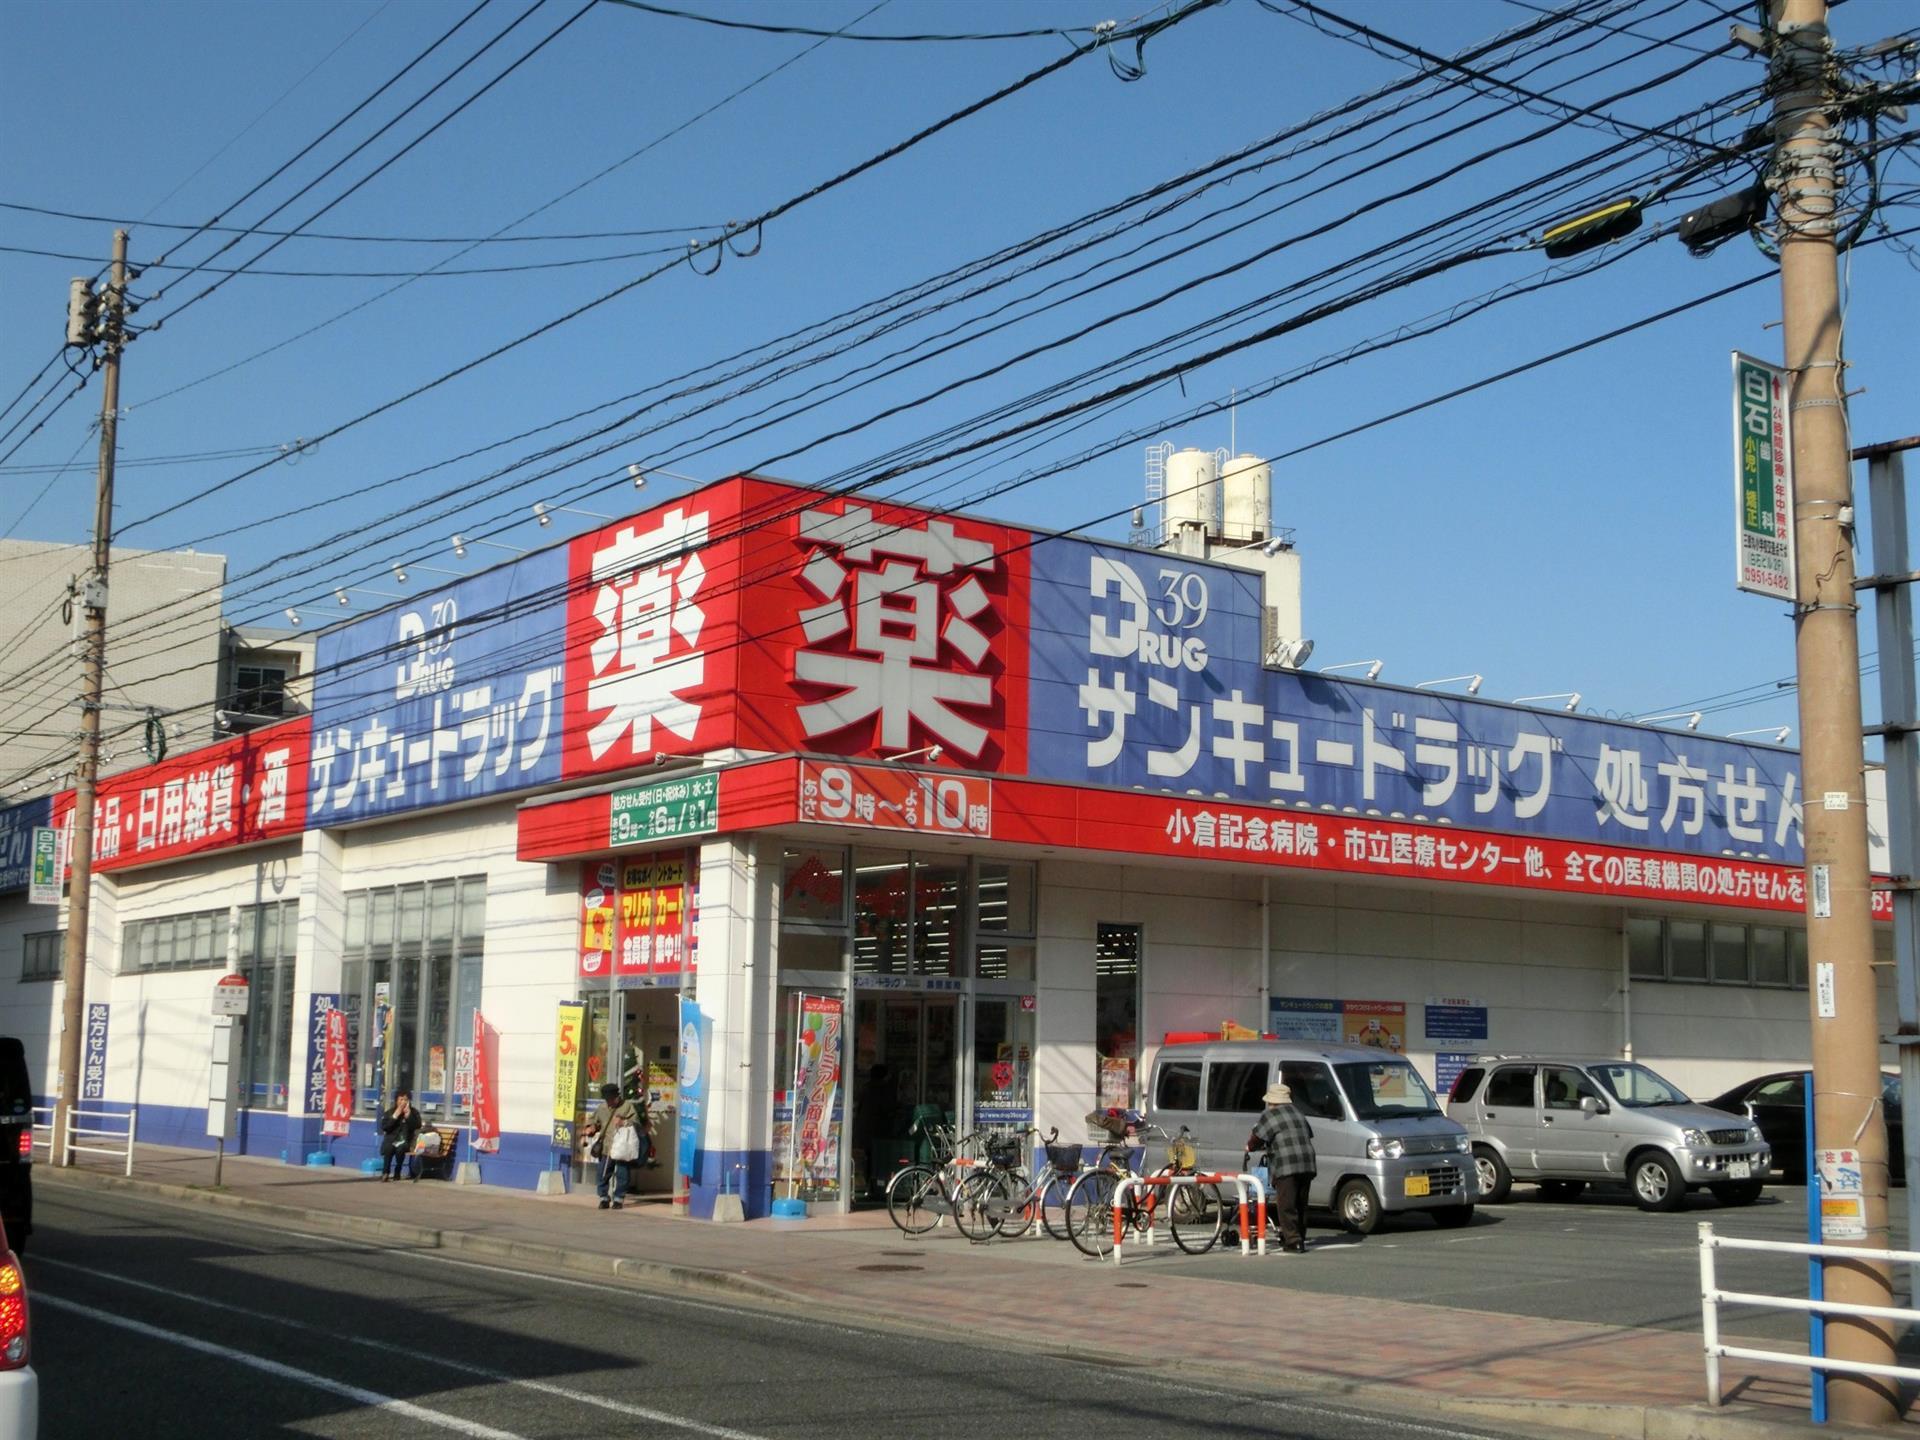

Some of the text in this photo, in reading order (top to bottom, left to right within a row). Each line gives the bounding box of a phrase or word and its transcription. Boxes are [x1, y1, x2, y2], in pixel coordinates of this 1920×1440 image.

[1744, 371, 1768, 436] 白石
[429, 598, 457, 654] 39
[586, 507, 709, 762] 薬
[794, 503, 996, 761] 薬
[1155, 569, 1208, 629] 39
[311, 664, 563, 815] サンキュードラッグ
[1079, 667, 1564, 819] サンキュードラッグ
[86, 1006, 107, 1097] 処方せん受付
[330, 1013, 349, 1118] 処方せん
